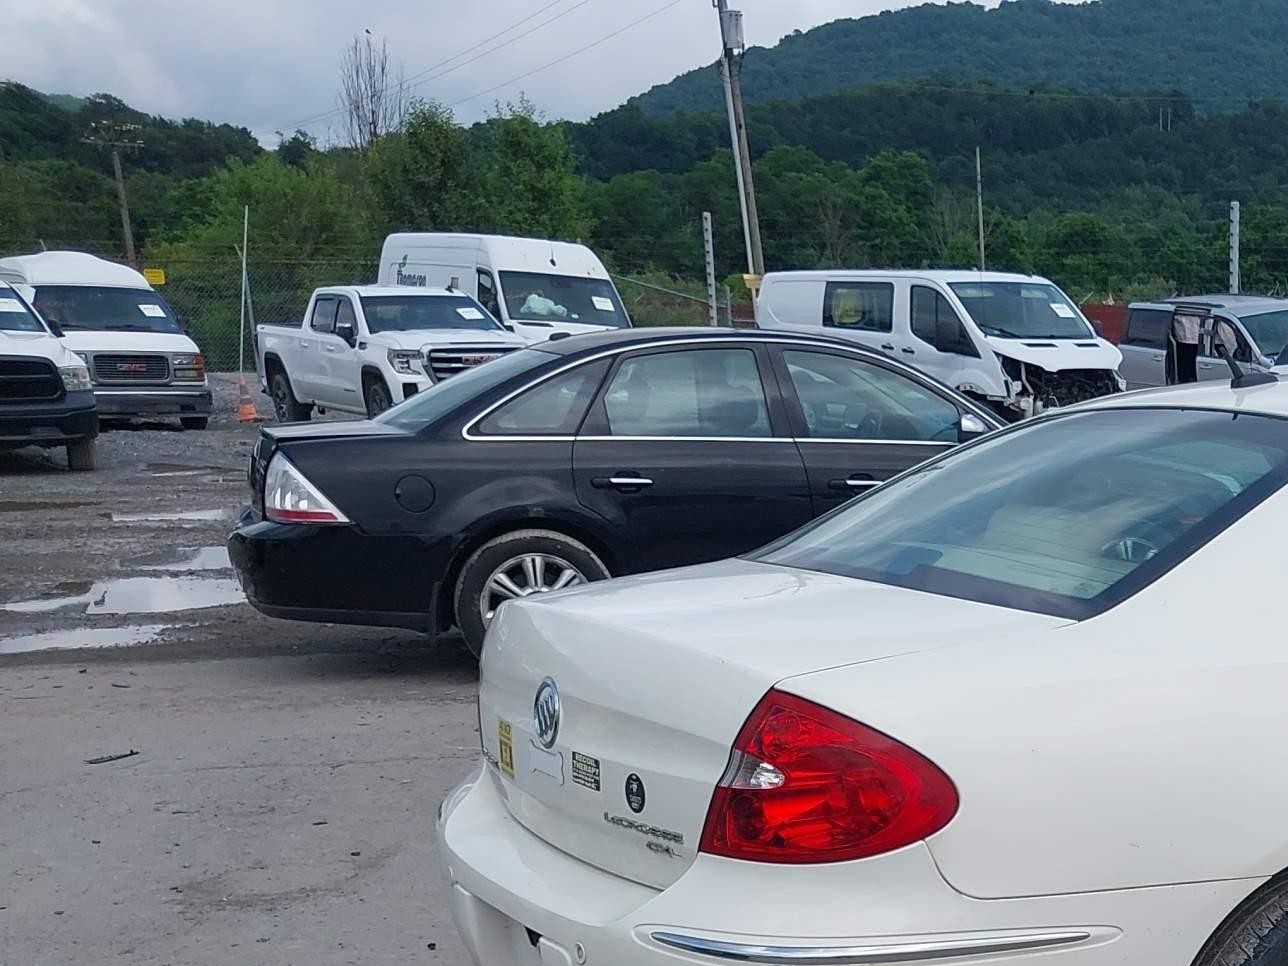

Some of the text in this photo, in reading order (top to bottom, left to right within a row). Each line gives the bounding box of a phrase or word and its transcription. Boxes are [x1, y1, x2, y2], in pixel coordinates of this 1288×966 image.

[116, 363, 147, 371] GMC
[575, 753, 597, 766] RECOIL
[573, 760, 599, 776] THERAPY
